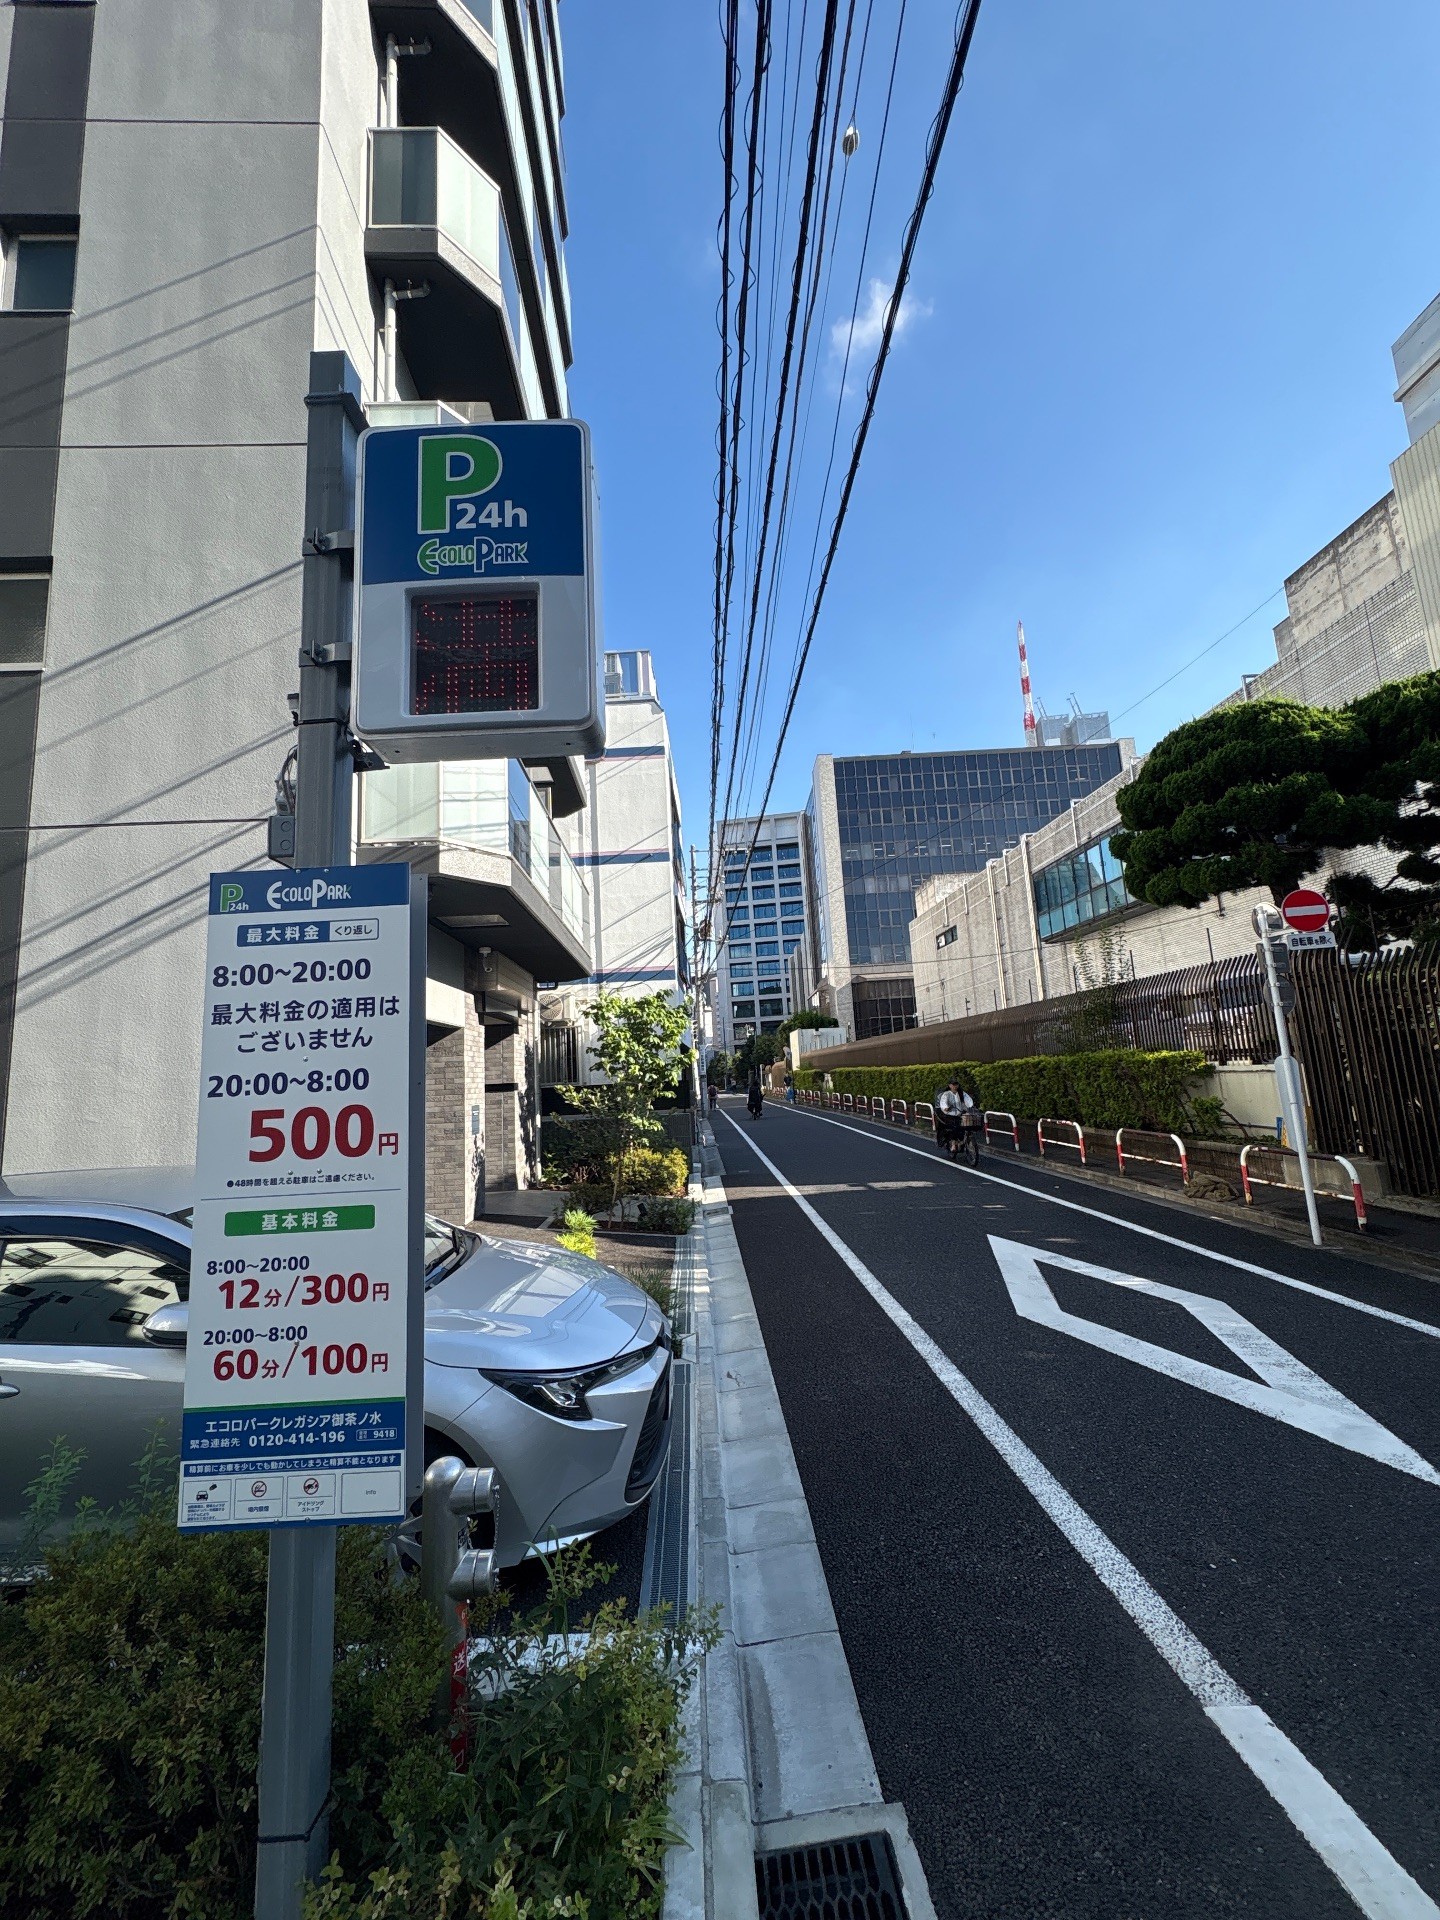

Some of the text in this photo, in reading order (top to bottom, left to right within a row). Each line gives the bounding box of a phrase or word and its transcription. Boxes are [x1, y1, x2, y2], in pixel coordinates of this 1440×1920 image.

[418, 435, 528, 535] P 24h
[220, 884, 249, 912] P 24h
[246, 925, 373, 943] 最大料金 くり返し
[1291, 935, 1332, 947] 自転車を除く
[211, 996, 400, 1025] 最大料金の適用は
[237, 1027, 374, 1053] ございません
[248, 1104, 399, 1162] 500円
[261, 1211, 339, 1230] 基本料金
[205, 1411, 382, 1433] エコロパークレガシア御茶ノ水
[189, 1438, 241, 1449] 緊急連絡先
[248, 1431, 346, 1448] 0120-414-196
[372, 1429, 395, 1439] 9418
